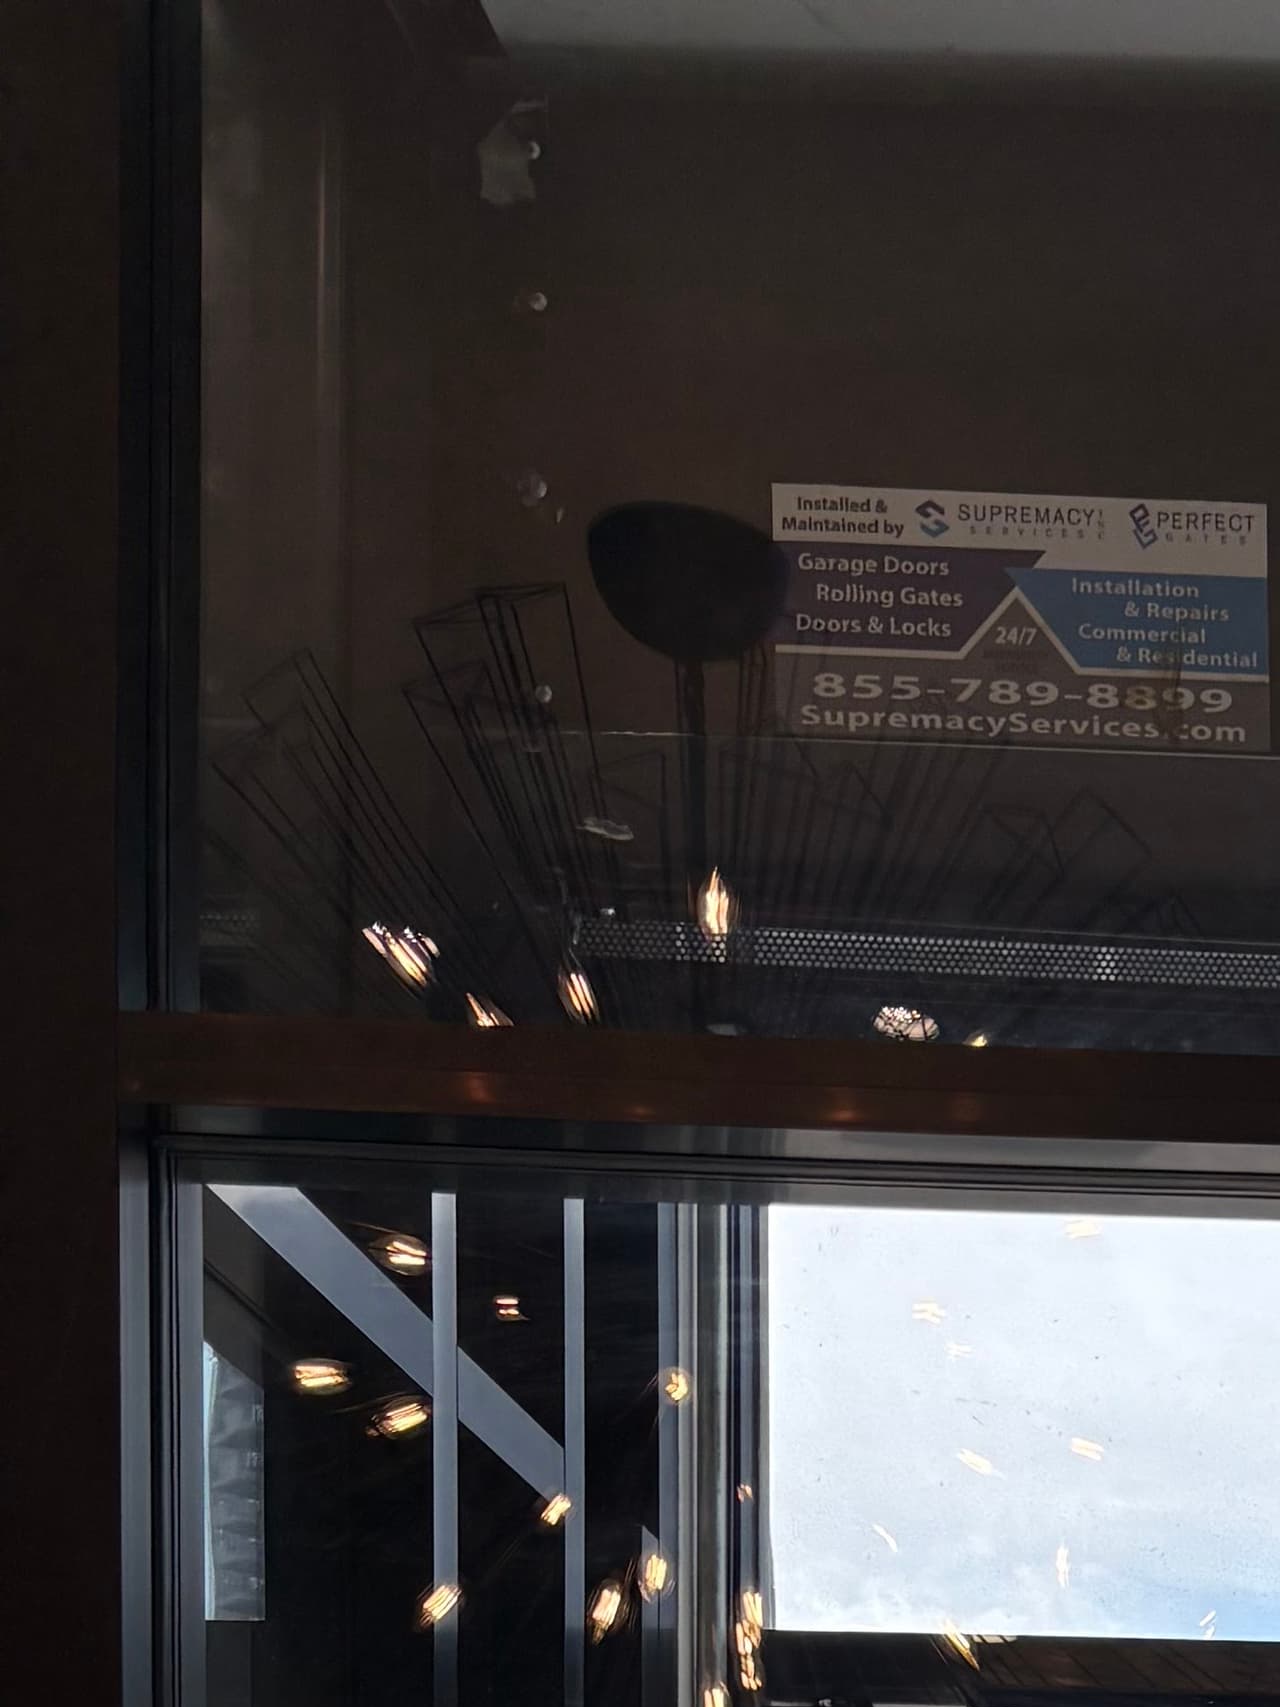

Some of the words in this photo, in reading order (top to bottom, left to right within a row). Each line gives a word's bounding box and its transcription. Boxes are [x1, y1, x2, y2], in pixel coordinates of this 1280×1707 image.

[797, 496, 871, 513] Installed
[875, 498, 888, 513] &
[958, 504, 1095, 526] SUPREMACY
[782, 517, 879, 534] Maintained
[884, 519, 904, 538] by
[1157, 511, 1256, 533] PERFECT
[970, 526, 1085, 540] SERVICES
[1165, 533, 1248, 547] GATES
[798, 553, 876, 576] Garage
[884, 556, 949, 575] Doors
[816, 584, 894, 608] Rolling
[901, 587, 964, 607] Gates
[1072, 577, 1200, 598] Installation
[1124, 602, 1139, 618] &
[1147, 603, 1230, 623] Repairs
[796, 614, 861, 633] Doors
[868, 616, 883, 634] &
[890, 617, 951, 638] Locks
[995, 626, 1037, 647] 24/7
[1079, 623, 1206, 644] Commercial
[1116, 647, 1132, 663] &
[1138, 646, 1258, 668] Resdential
[813, 672, 1233, 714] 855-789-8899
